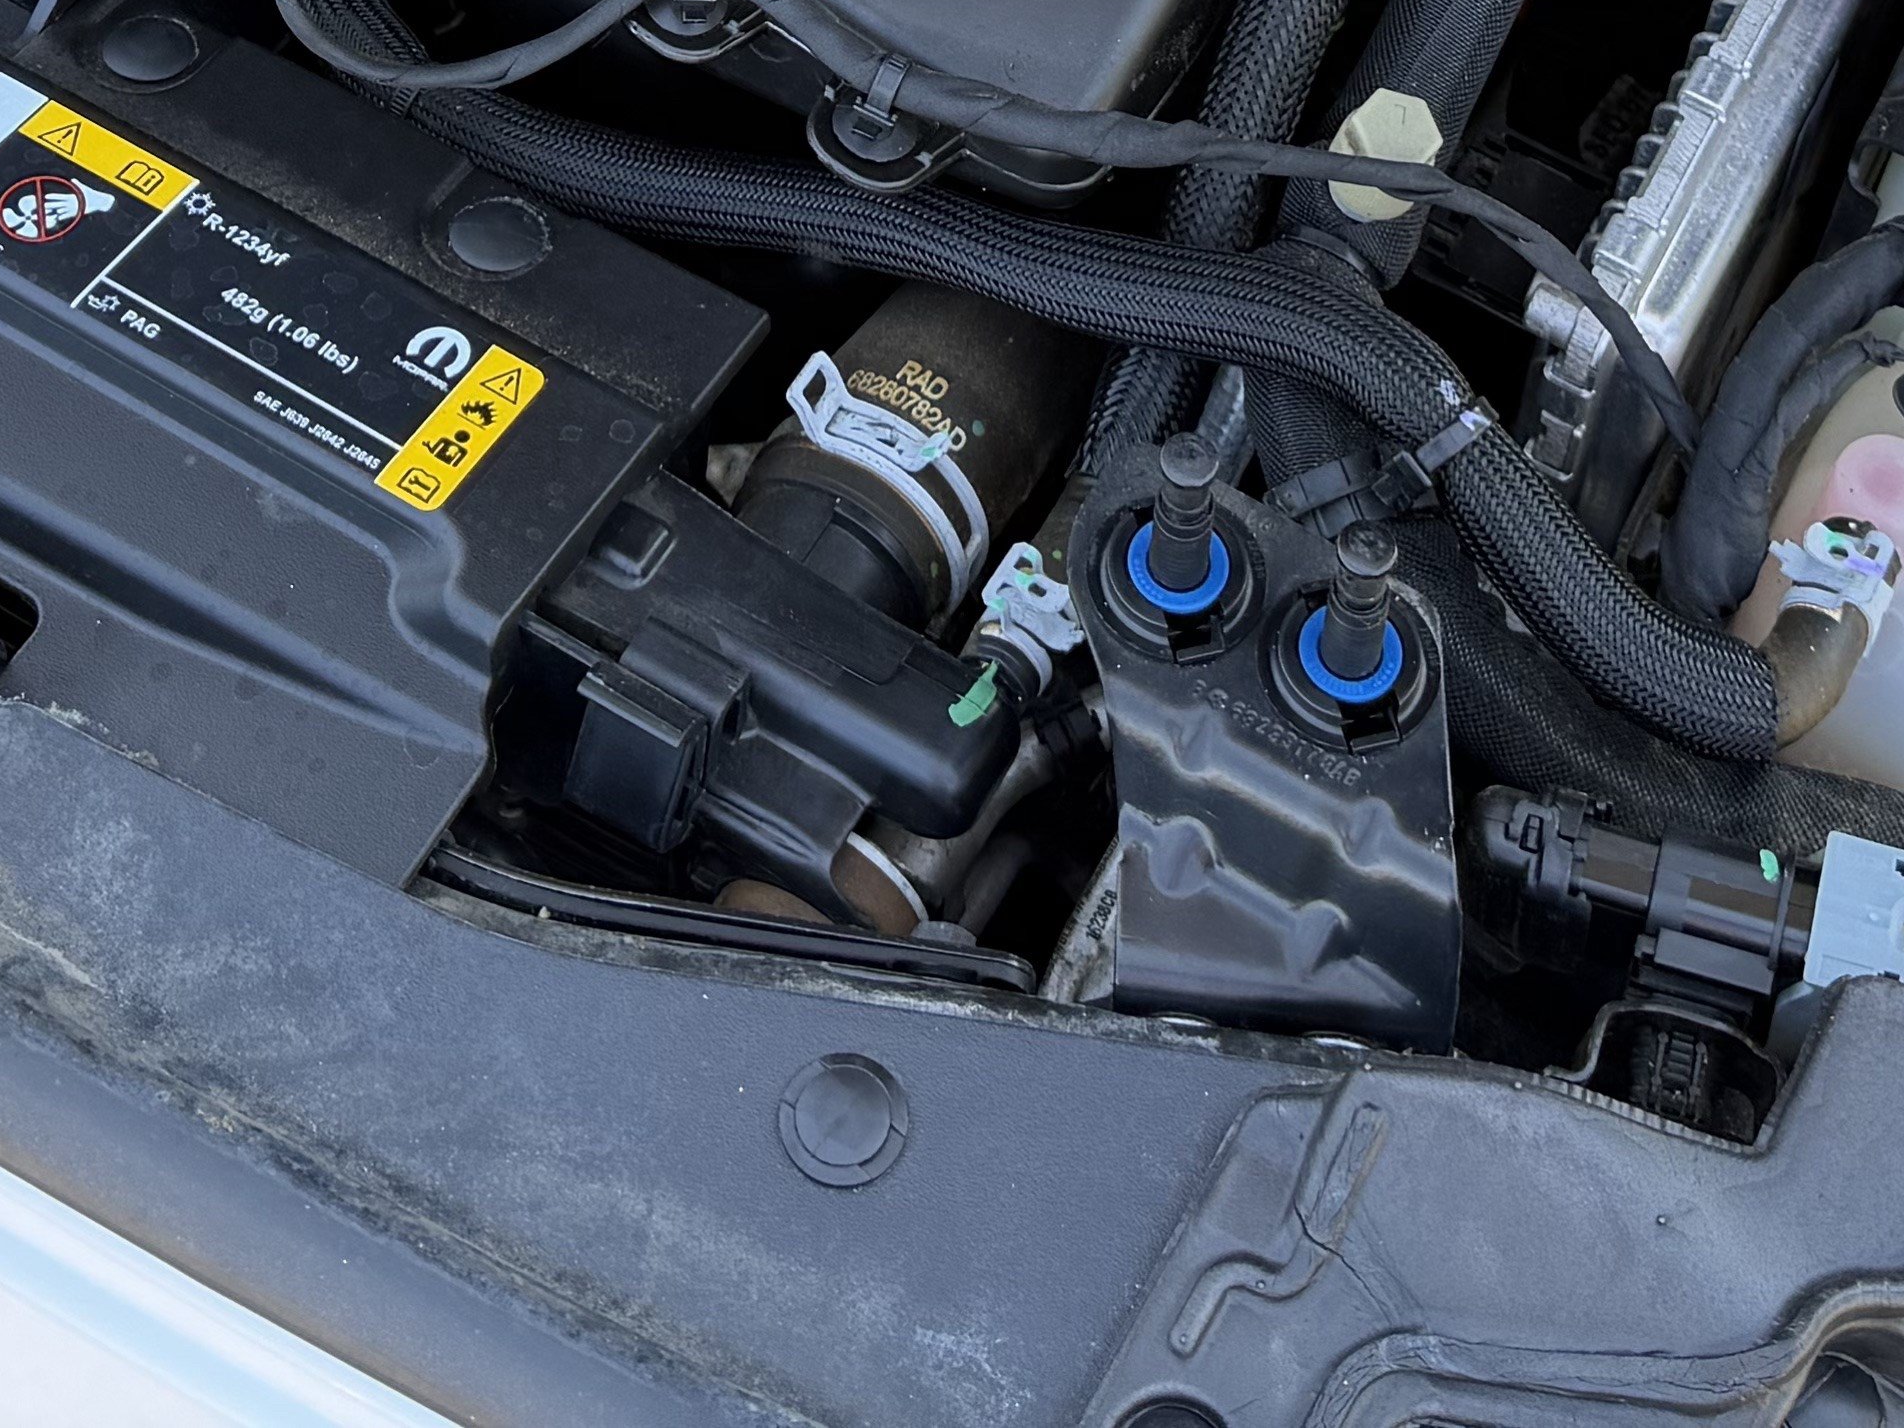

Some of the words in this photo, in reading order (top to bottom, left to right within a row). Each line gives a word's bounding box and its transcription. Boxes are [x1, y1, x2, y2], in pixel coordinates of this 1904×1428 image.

[202, 212, 291, 268] R-1234yf
[119, 307, 161, 339] PAG
[220, 285, 269, 330] 482g
[267, 310, 319, 354] (1.06
[316, 339, 361, 374] lbs)
[252, 389, 282, 414] SAE
[894, 360, 950, 402] RAD
